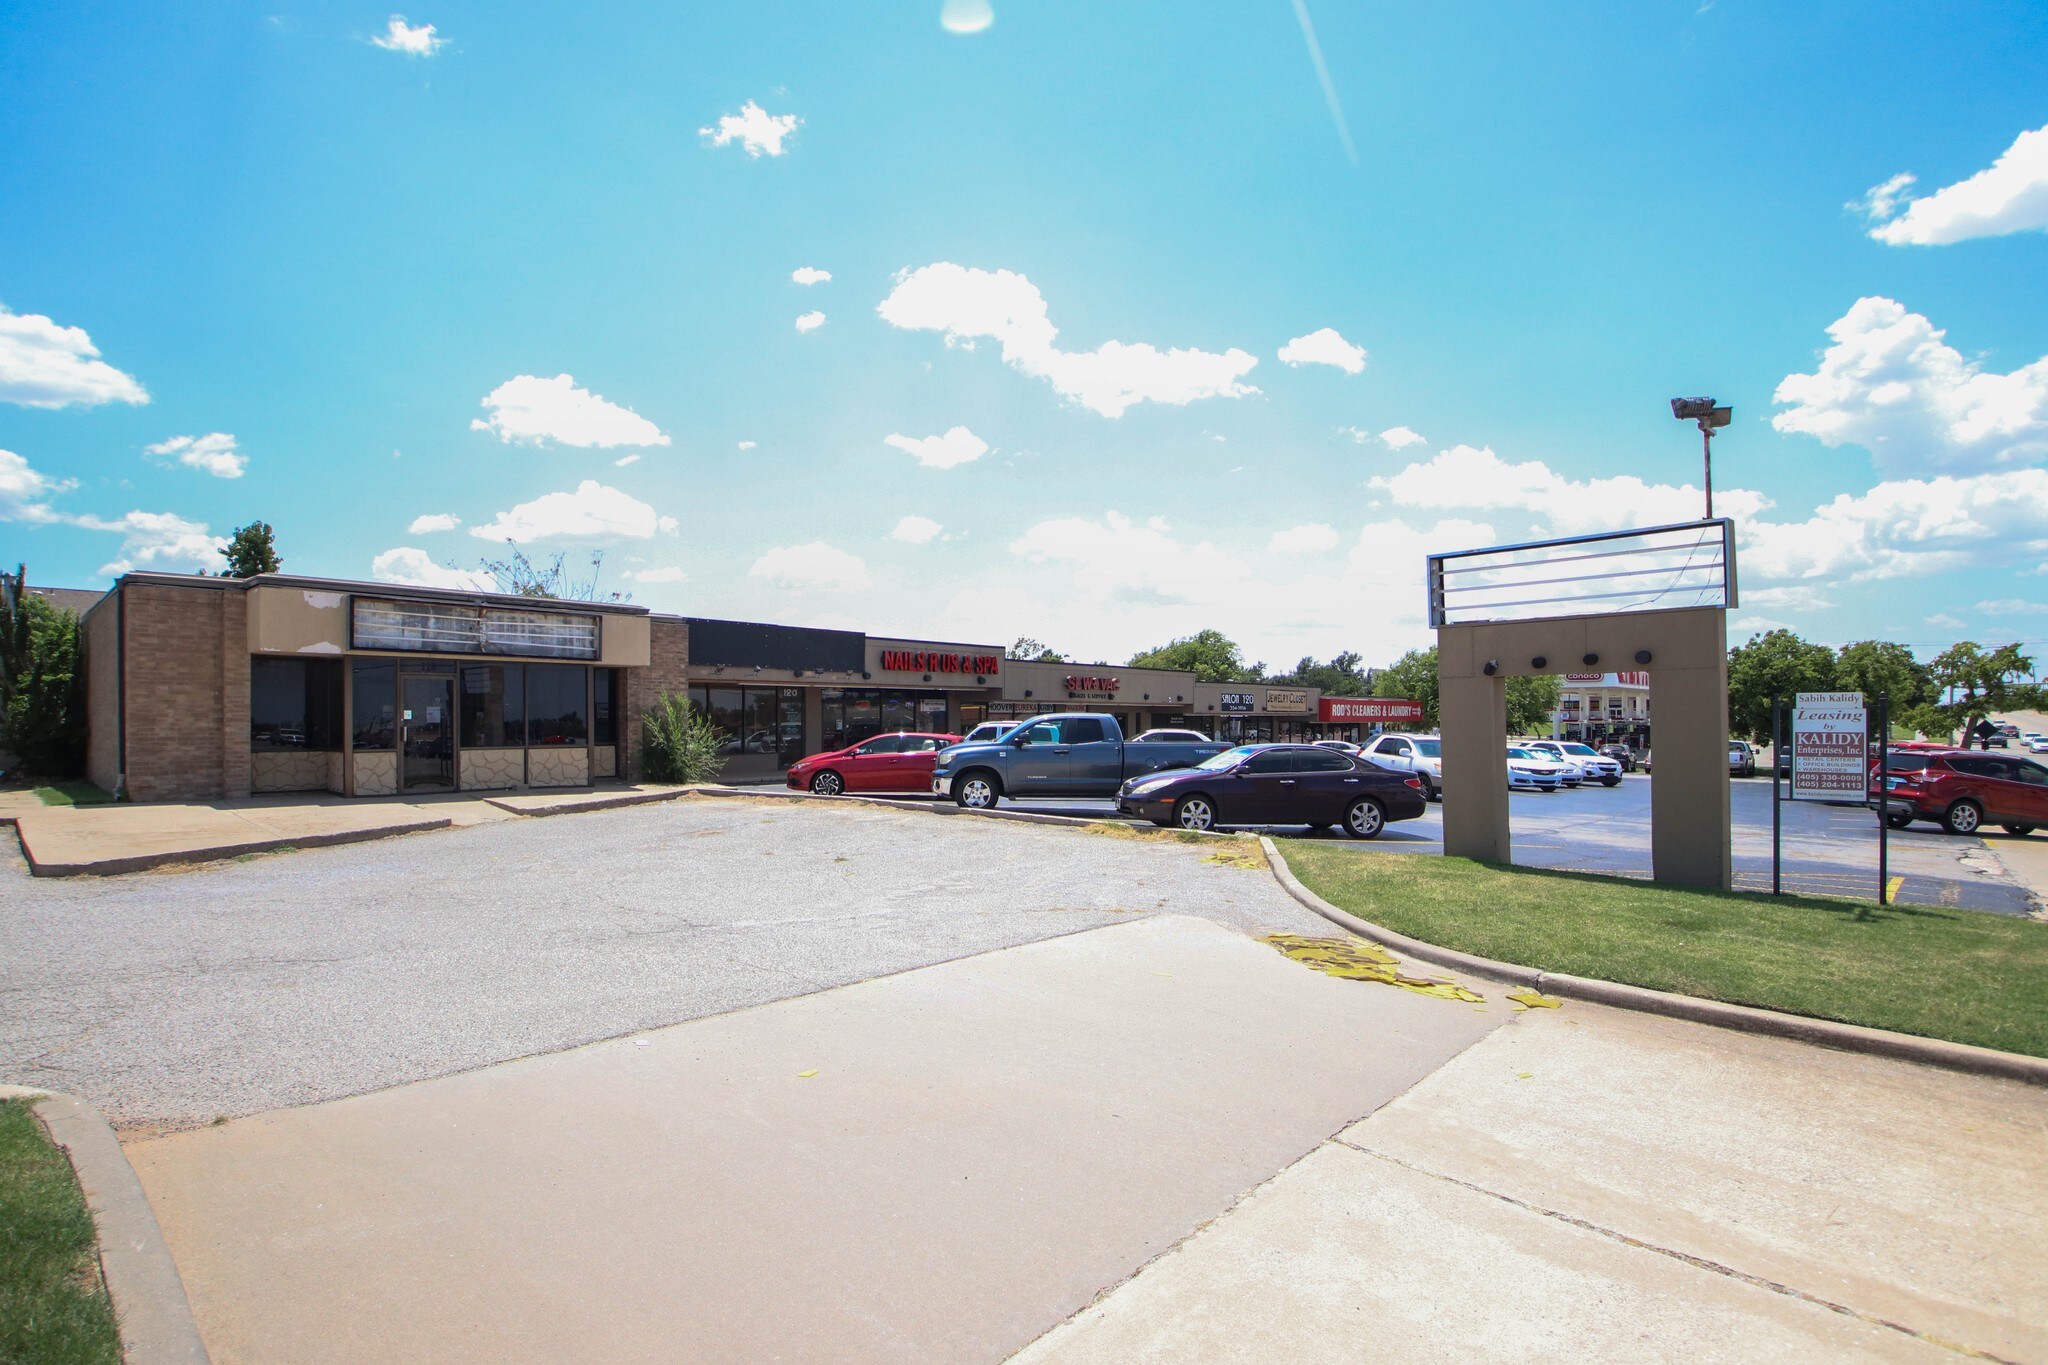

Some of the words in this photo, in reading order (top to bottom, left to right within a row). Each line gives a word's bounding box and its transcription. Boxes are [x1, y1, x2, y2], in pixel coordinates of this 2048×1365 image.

[883, 650, 926, 672] NAILS
[928, 653, 939, 672] R
[941, 653, 959, 673] US
[962, 655, 973, 674] &
[975, 656, 999, 675] SPA
[1066, 676, 1091, 691] SEW
[1099, 678, 1121, 691] VAC
[783, 688, 798, 697] 120
[1222, 693, 1240, 704] SALON
[1267, 692, 1289, 703] JEWELRY
[1289, 693, 1307, 704] CLOSET
[1798, 694, 1826, 703] Sabih
[1829, 693, 1860, 705] Kalidy
[988, 703, 1013, 711] HOOVER
[1015, 703, 1038, 711] EUREKA
[1332, 704, 1351, 717] ROD'S
[1352, 704, 1381, 717] CLEANERS
[1382, 705, 1388, 717] &
[1388, 705, 1412, 717] LAUNDRY
[1797, 710, 1863, 723] Leasing
[1823, 723, 1836, 731] by
[1797, 733, 1863, 745] KALIDY
[1797, 746, 1845, 756] Enterprises,
[1846, 746, 1862, 755] Inc.
